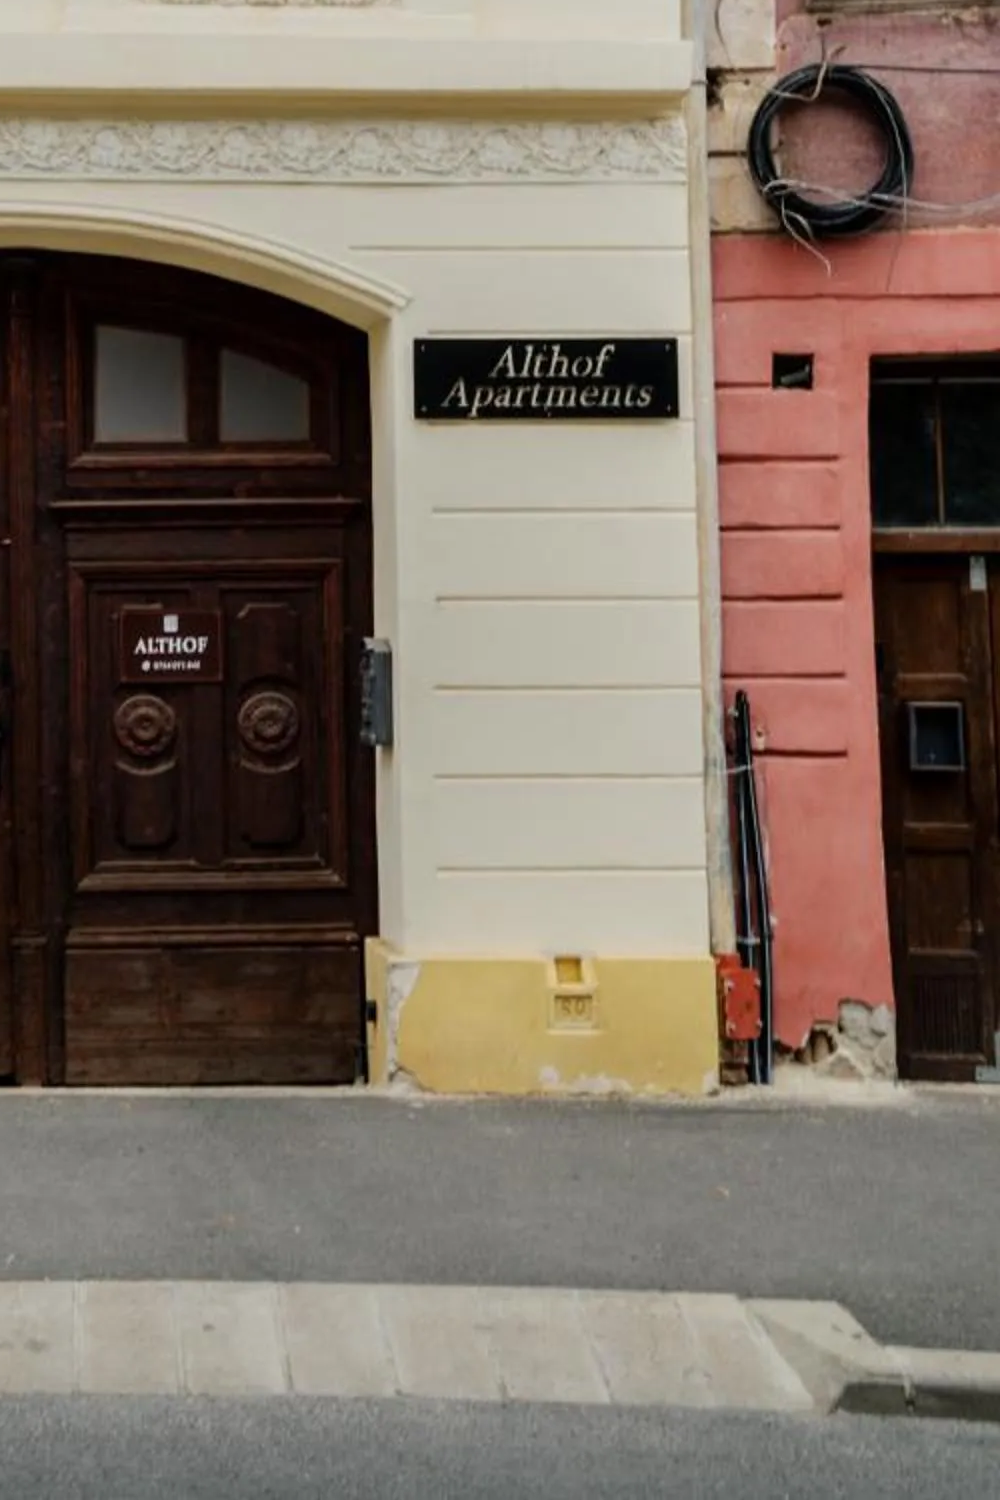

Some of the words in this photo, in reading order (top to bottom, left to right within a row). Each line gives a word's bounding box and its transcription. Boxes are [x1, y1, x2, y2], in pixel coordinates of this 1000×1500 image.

[488, 344, 615, 378] Althof
[441, 376, 654, 417] Apartments
[134, 636, 209, 655] ALTHOF
